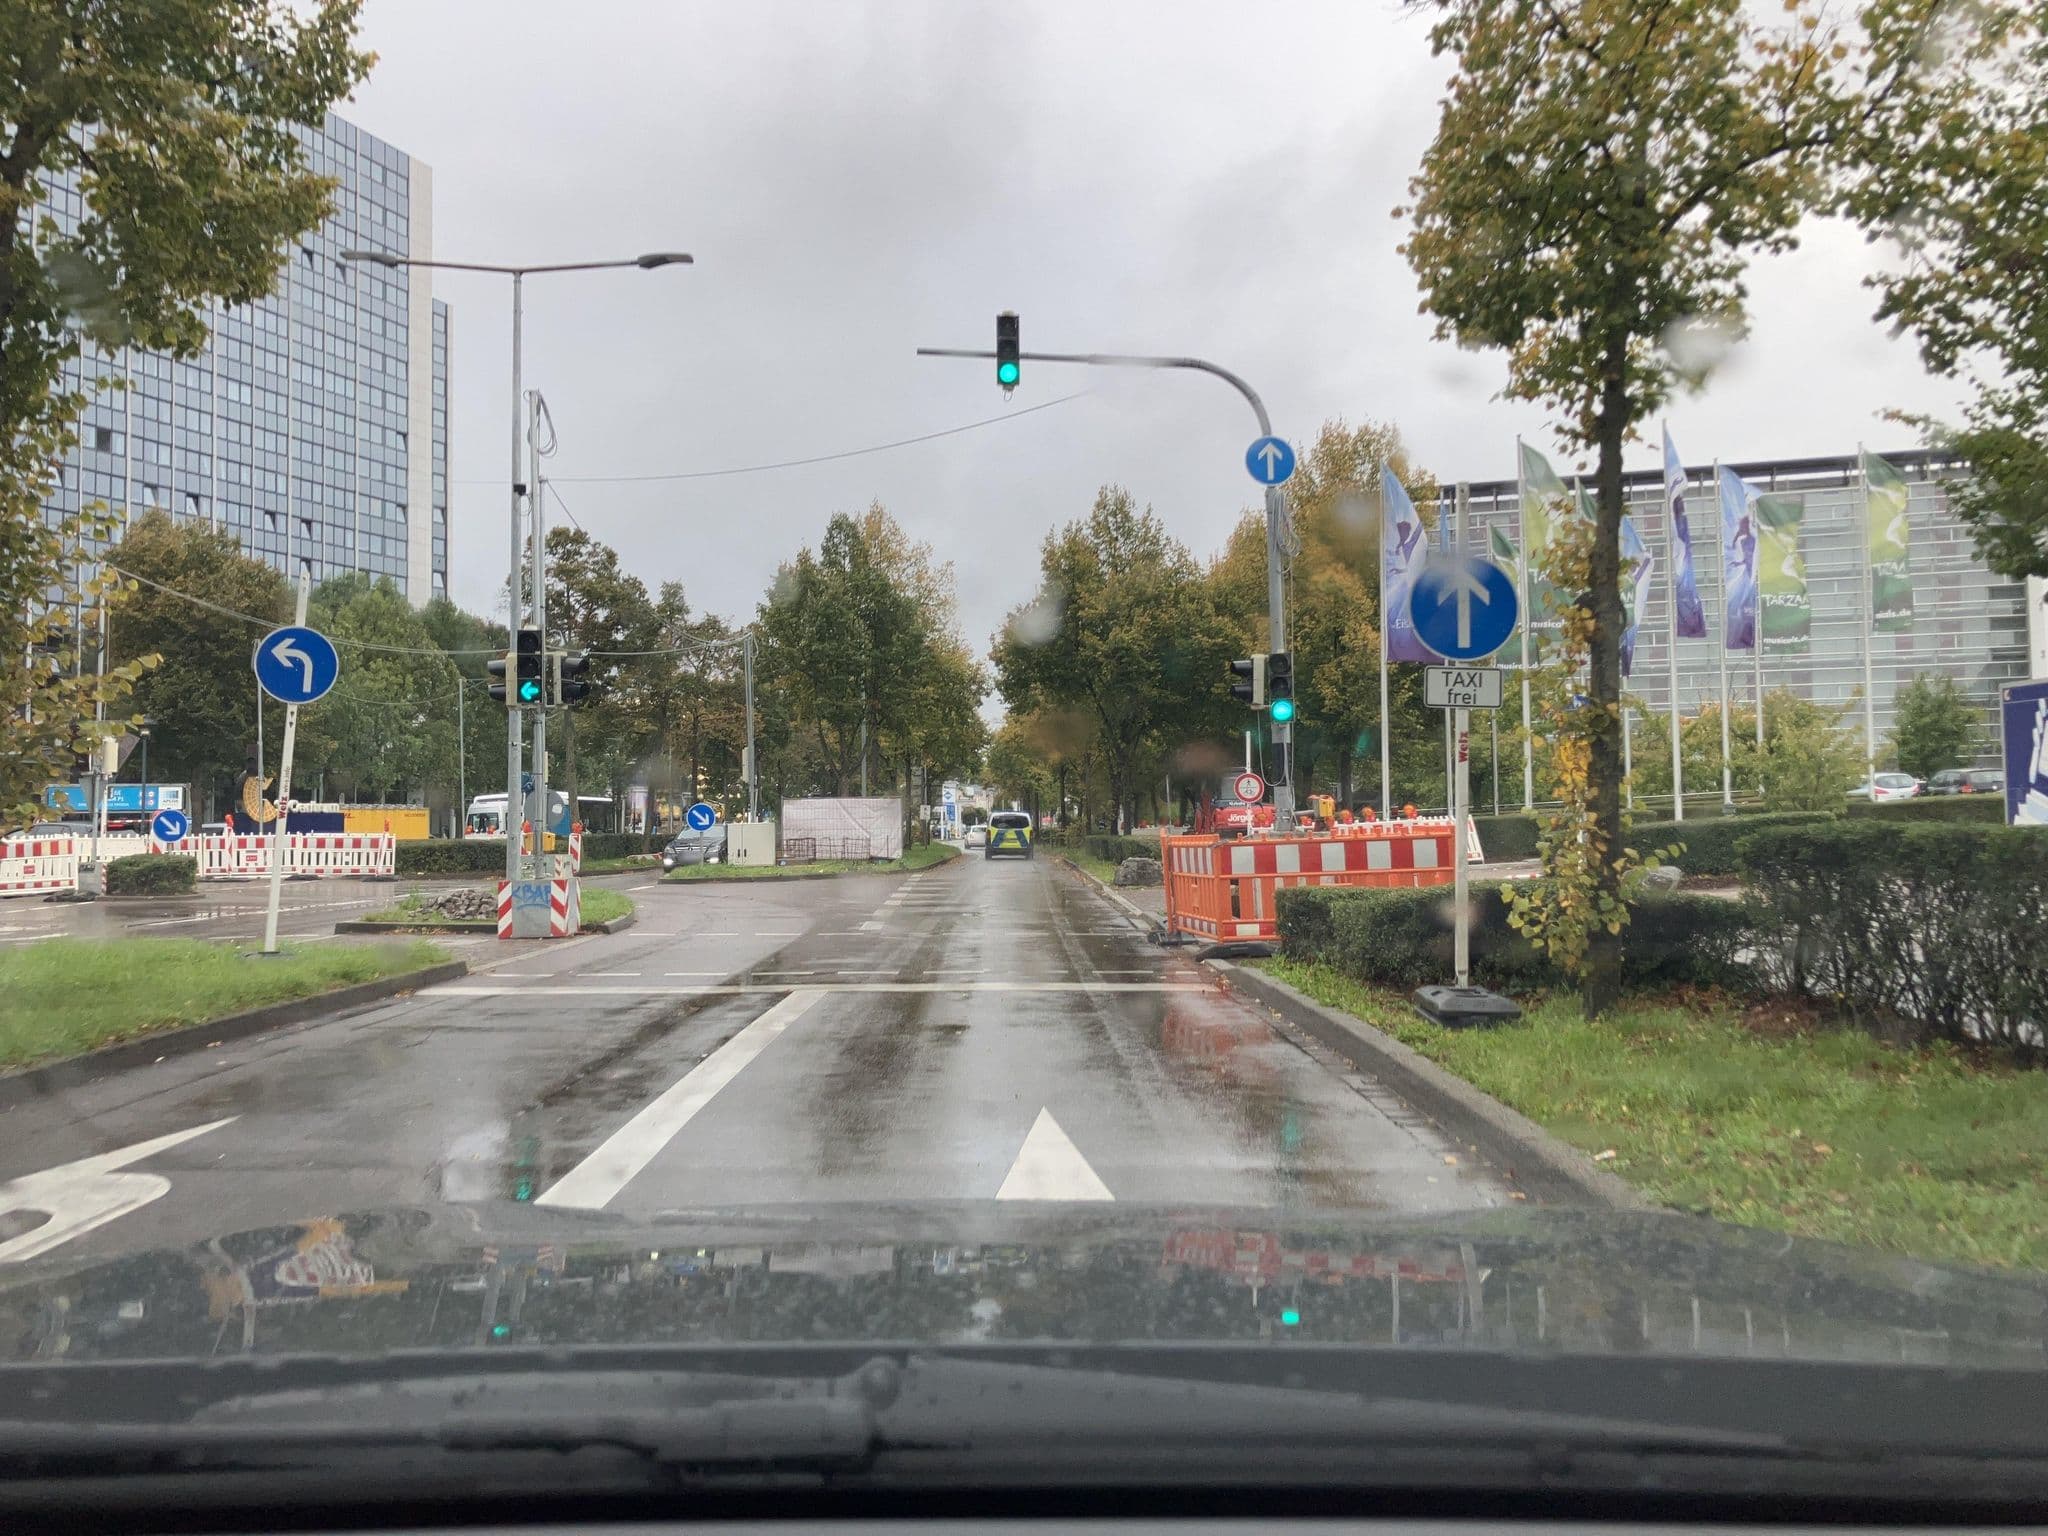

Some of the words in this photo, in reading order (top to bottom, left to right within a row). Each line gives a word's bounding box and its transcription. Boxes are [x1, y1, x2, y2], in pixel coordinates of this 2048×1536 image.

[1530, 618, 1568, 628] musical
[1441, 671, 1483, 688] TAXI
[1447, 688, 1477, 704] frei
